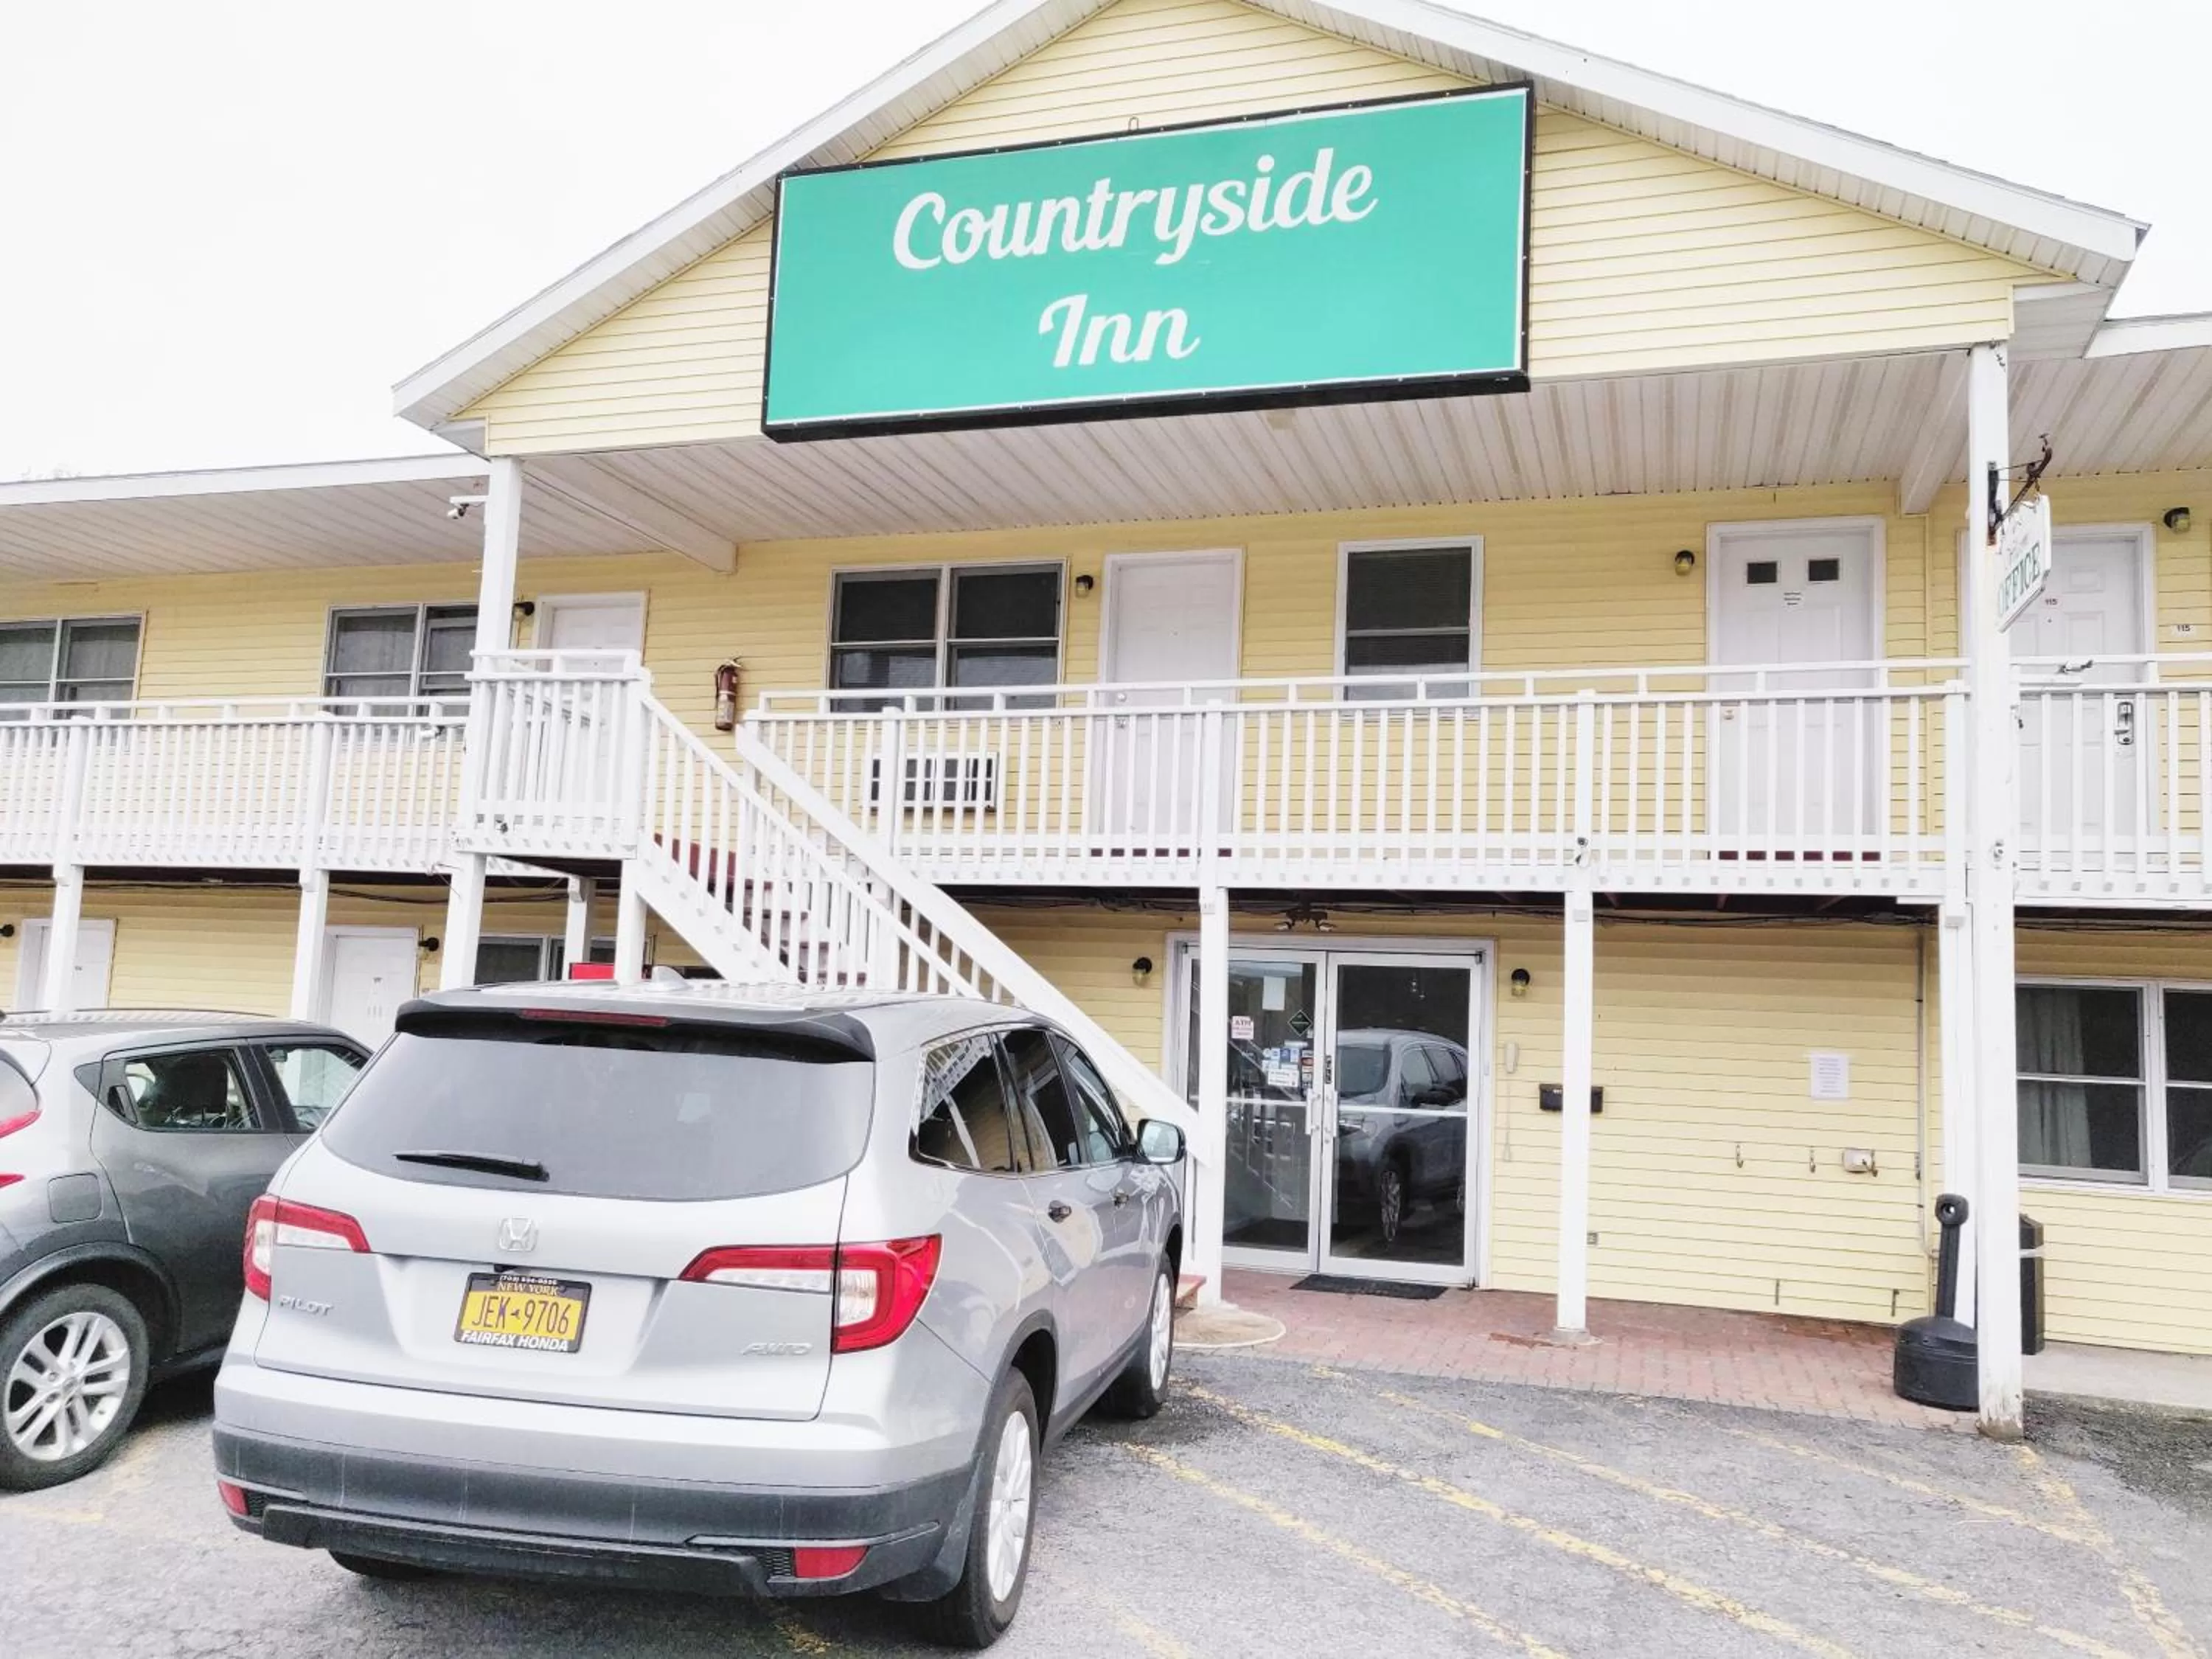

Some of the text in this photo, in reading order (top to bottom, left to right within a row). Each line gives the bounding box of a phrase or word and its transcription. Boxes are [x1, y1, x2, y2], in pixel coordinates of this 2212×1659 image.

[893, 147, 1377, 268] Countryside
[1038, 293, 1200, 368] Inn
[1999, 542, 2040, 618] OFFICE
[279, 1295, 334, 1315] PILOT
[497, 1282, 558, 1296] NEW YORK
[461, 1329, 568, 1352] FAIRFAX HONDA
